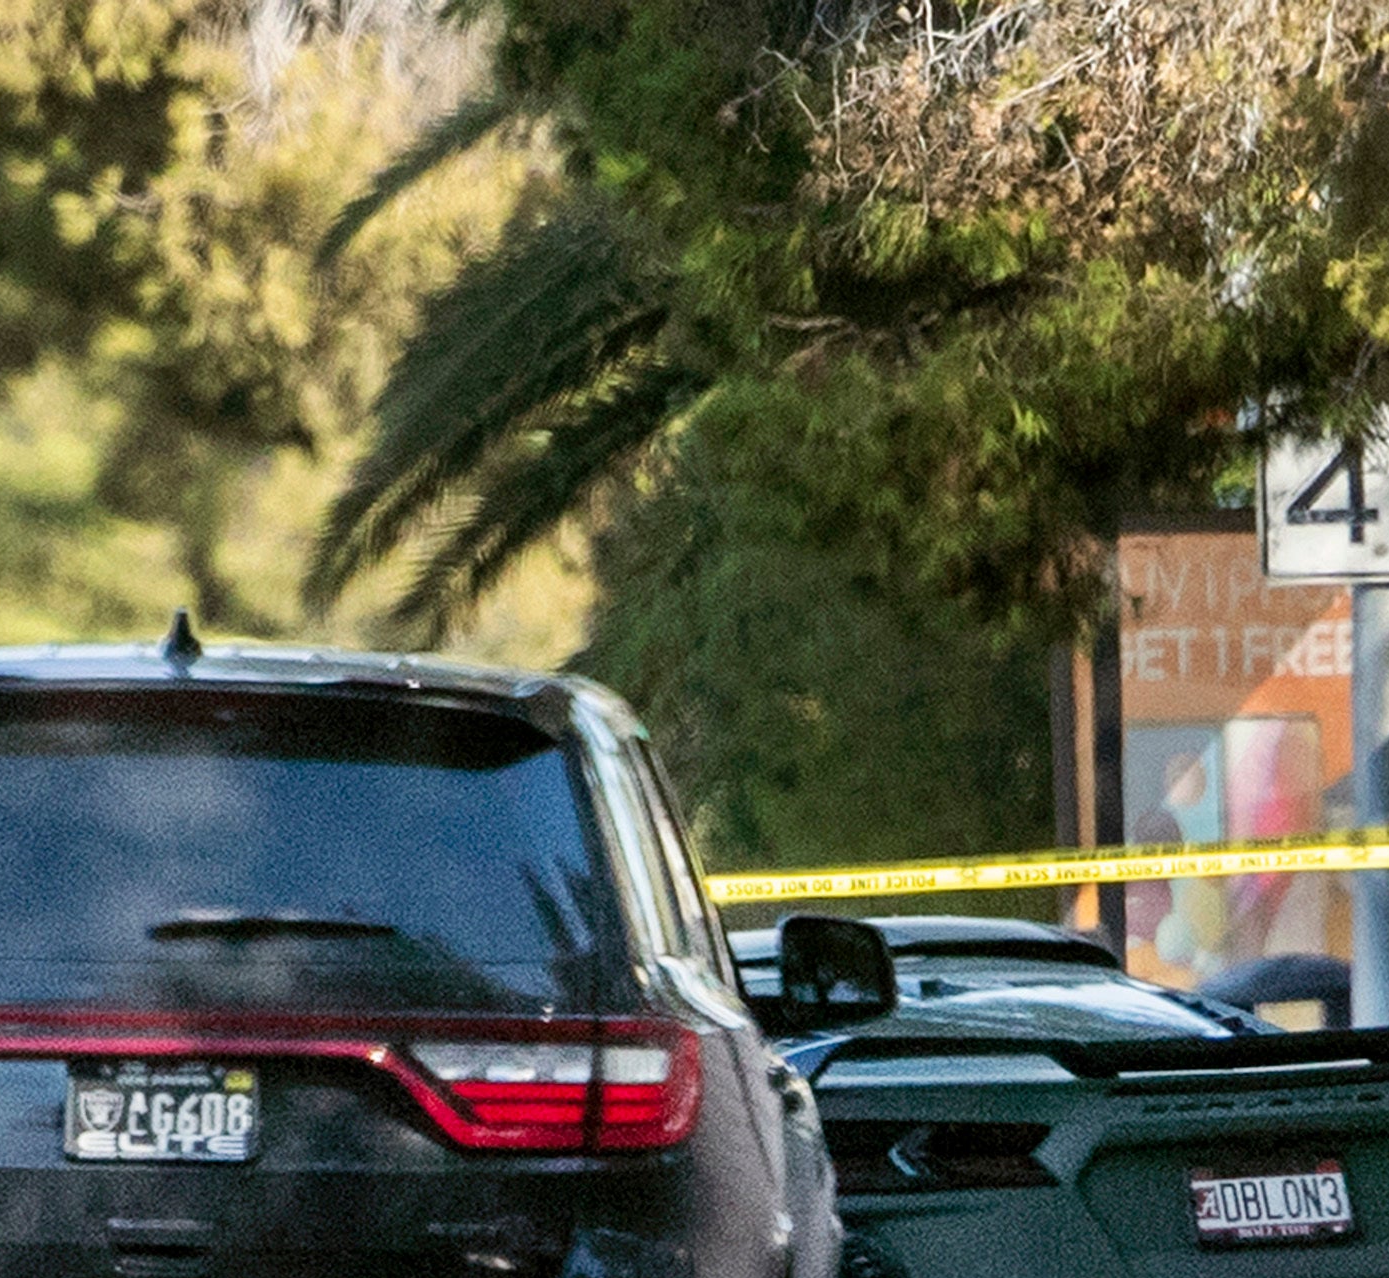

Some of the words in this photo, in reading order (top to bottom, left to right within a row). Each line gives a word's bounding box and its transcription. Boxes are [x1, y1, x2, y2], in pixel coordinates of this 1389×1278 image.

[1120, 557, 1191, 612] UY
[1241, 619, 1354, 678] FREE
[1201, 859, 1222, 872] DO
[1240, 855, 1270, 868] LINE
[1275, 853, 1327, 867] POLICE
[1004, 868, 1049, 883] SCENE
[1056, 865, 1101, 880] CRIME
[1116, 862, 1164, 877] CROSS
[1171, 861, 1197, 875] NOT
[726, 881, 774, 897] CROSS
[780, 880, 808, 895] NOT
[812, 879, 833, 893] DO
[850, 877, 880, 891] LINE
[885, 874, 937, 889] POLICE
[77, 1130, 248, 1154] ELITE
[1219, 1176, 1345, 1223] DBLON3
